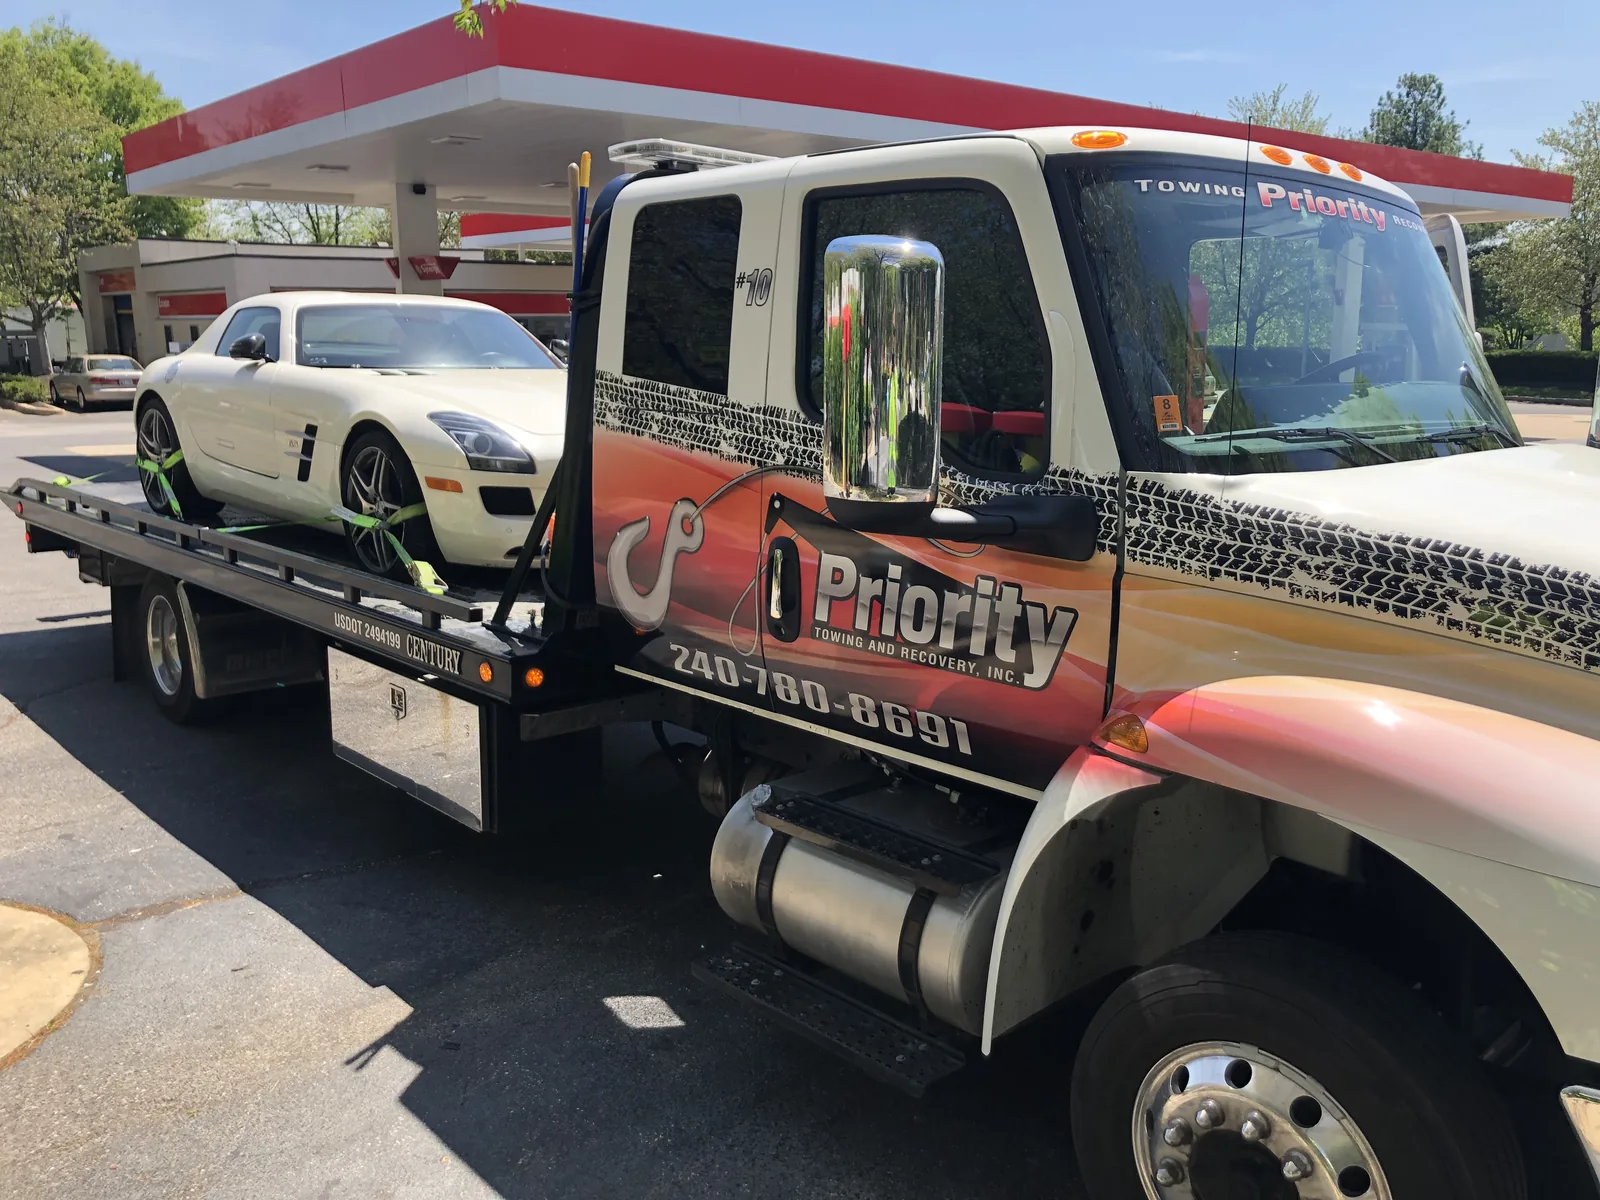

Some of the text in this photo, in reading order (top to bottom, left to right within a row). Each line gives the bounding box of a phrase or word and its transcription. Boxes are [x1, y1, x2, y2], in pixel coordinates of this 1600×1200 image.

[1134, 179, 1245, 197] TOWING
[1256, 181, 1386, 232] Priority
[736, 267, 773, 307] #10
[1162, 398, 1171, 410] 8
[334, 612, 401, 649] USDOT 2494199
[814, 549, 1077, 690] Priority
[406, 633, 461, 675] CENTURY
[813, 626, 1021, 686] TOWING AND RECOVERY, INC.
[670, 644, 973, 756] 240-780-8691
